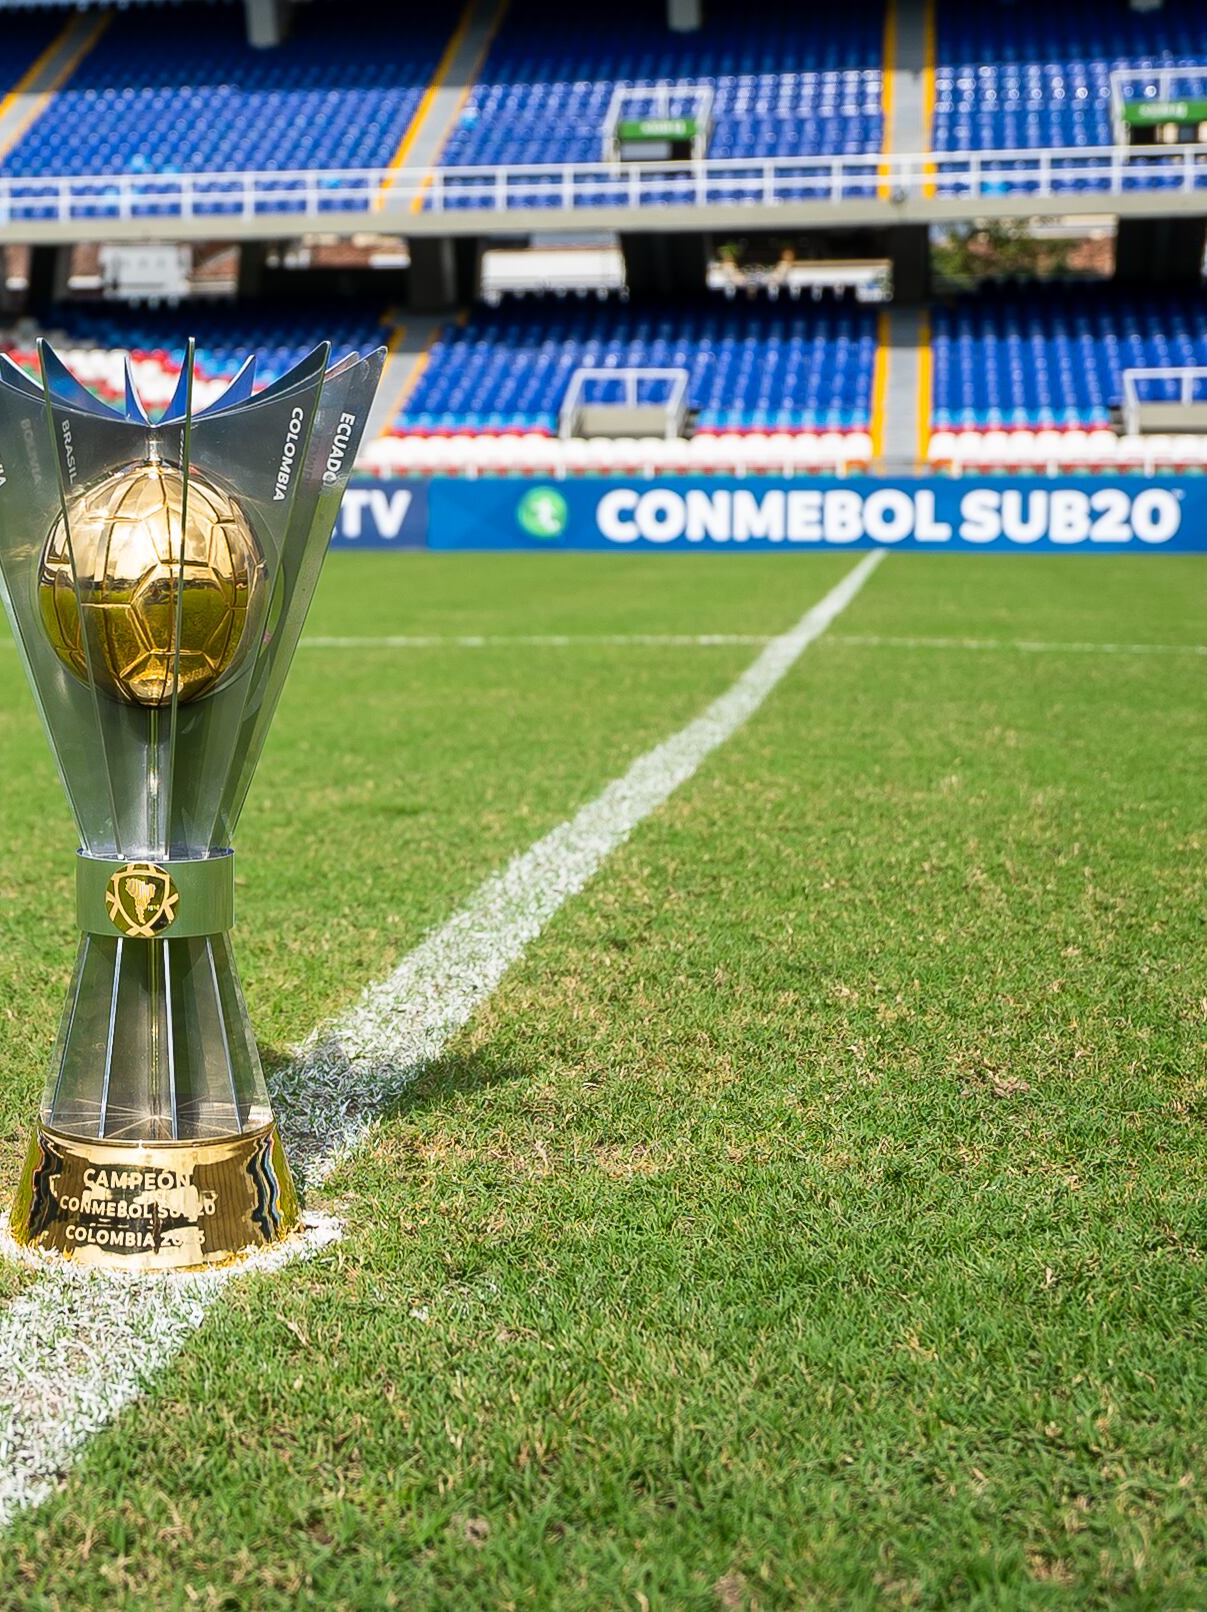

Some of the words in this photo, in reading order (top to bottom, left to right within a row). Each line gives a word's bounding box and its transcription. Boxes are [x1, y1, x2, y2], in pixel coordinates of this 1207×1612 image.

[61, 419, 78, 485] BRASIL
[273, 407, 304, 501] COLOMBIA
[322, 412, 356, 486] ECUADO
[333, 488, 412, 539] TV
[596, 488, 952, 543] CONMEBOL
[959, 488, 1182, 543] SUB20
[60, 1195, 152, 1218] CONMEBOL
[158, 1199, 216, 1219] SU20
[65, 1225, 156, 1247] COLOMBIA
